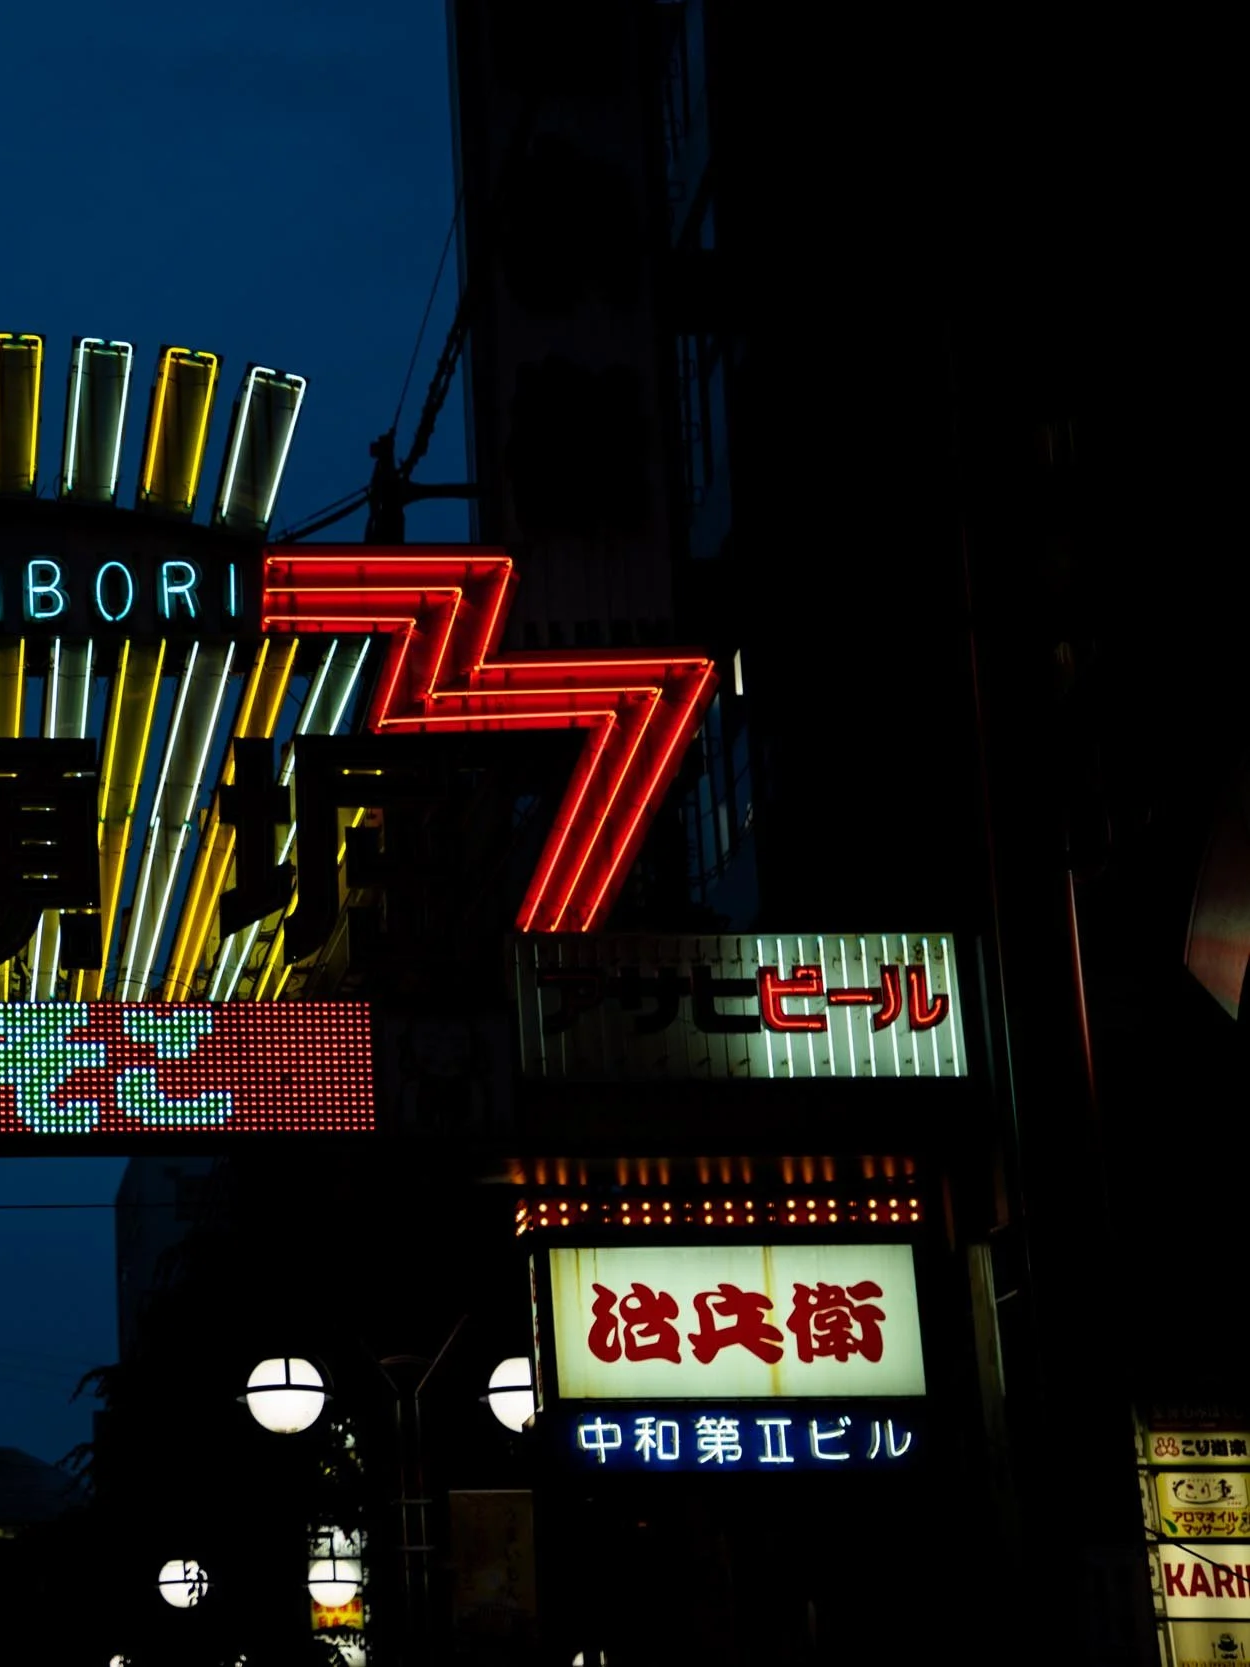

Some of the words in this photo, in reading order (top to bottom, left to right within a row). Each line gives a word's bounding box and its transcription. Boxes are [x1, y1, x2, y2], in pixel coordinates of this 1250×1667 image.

[587, 1280, 886, 1365] 治兵衛
[1172, 1511, 1239, 1523] アロマオイル
[1182, 1523, 1236, 1536] マッサージ
[1163, 1562, 1250, 1598] KARI
